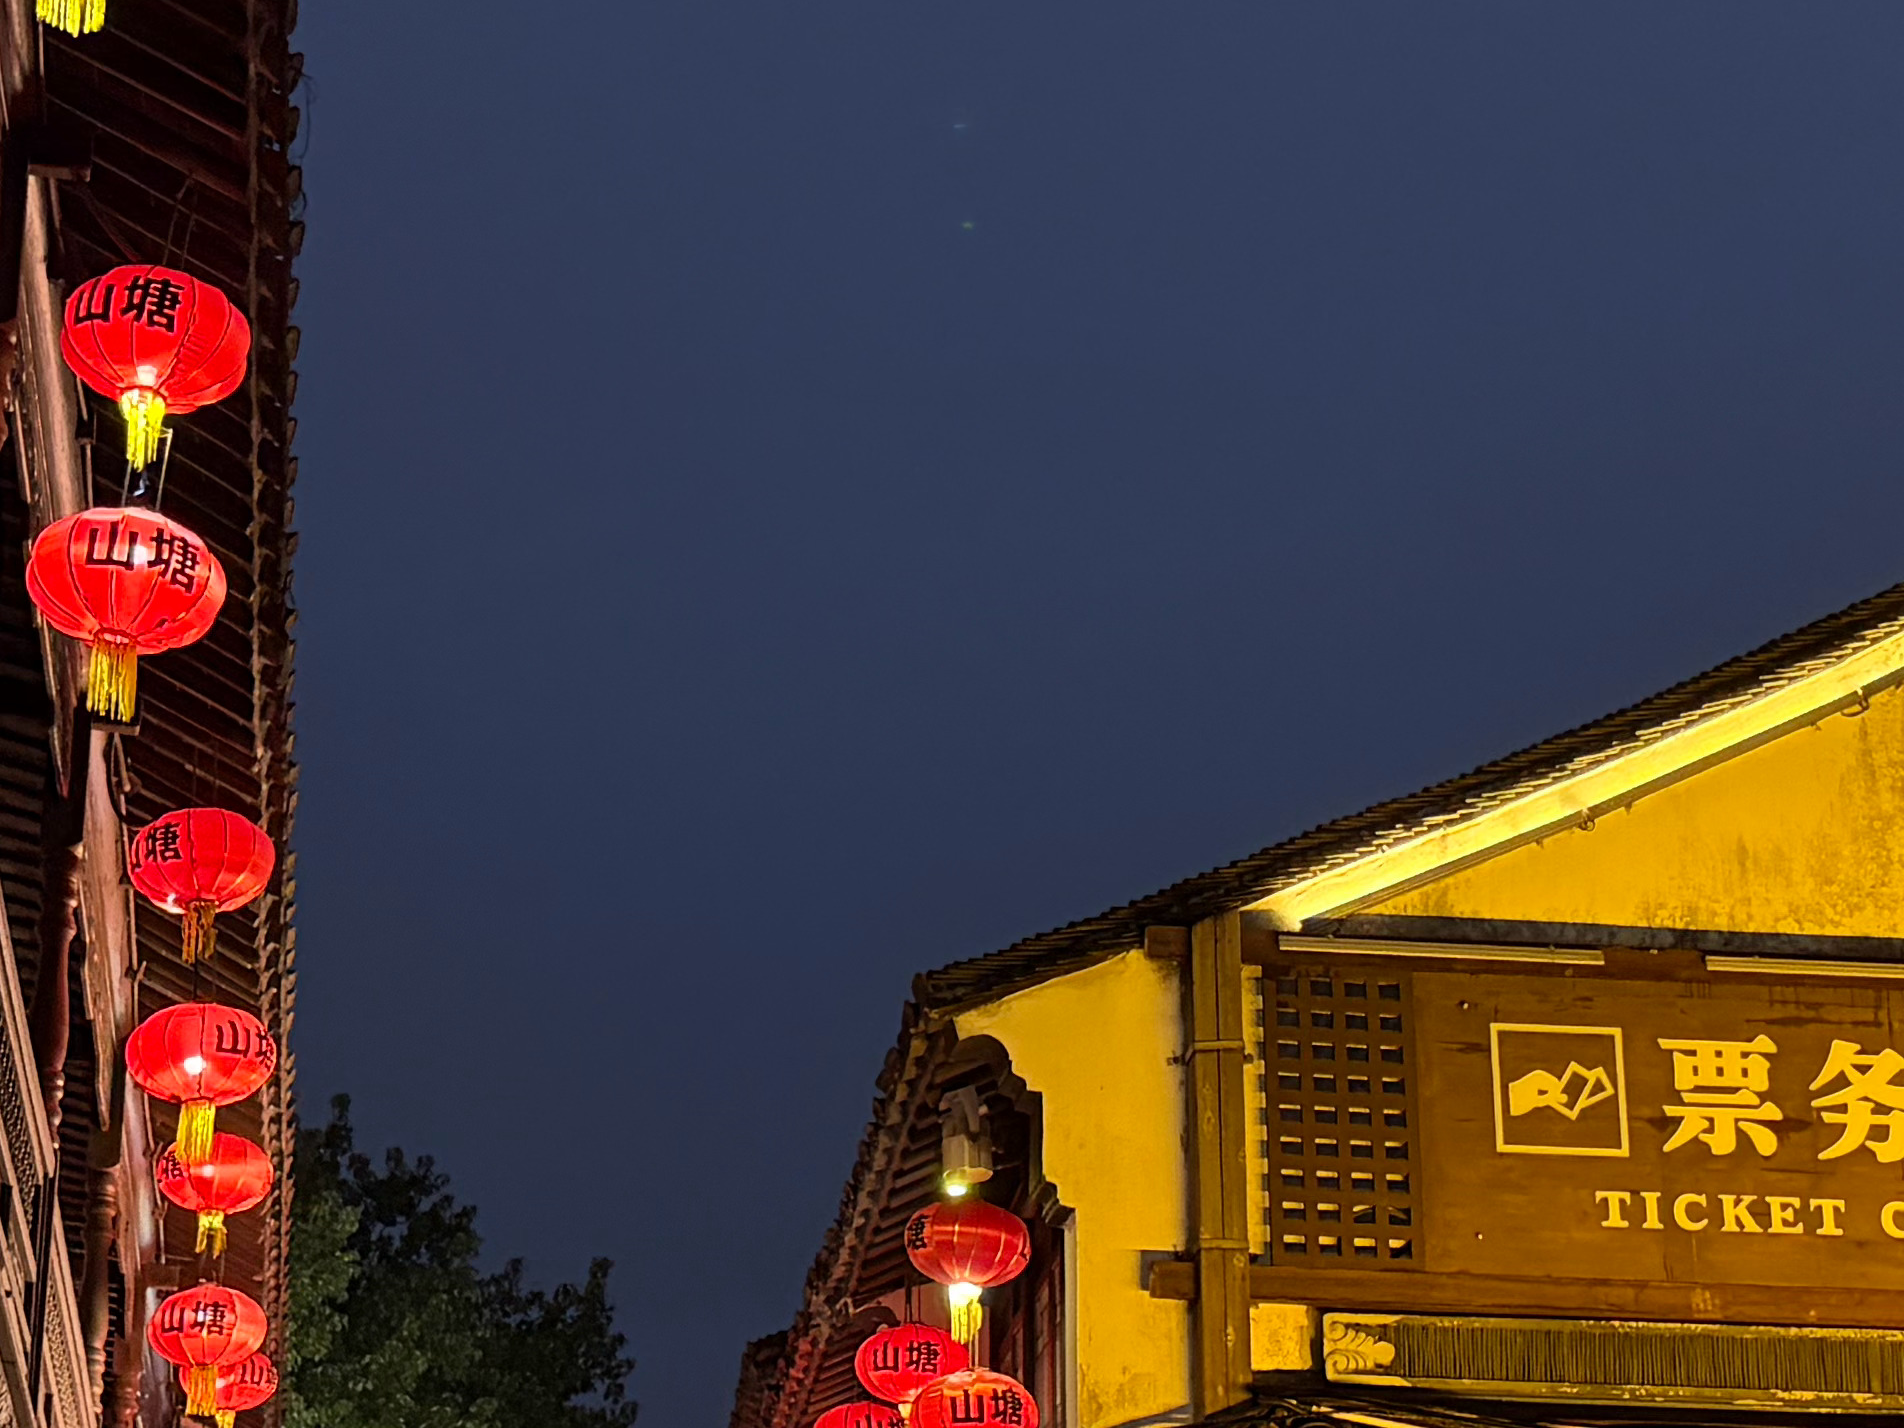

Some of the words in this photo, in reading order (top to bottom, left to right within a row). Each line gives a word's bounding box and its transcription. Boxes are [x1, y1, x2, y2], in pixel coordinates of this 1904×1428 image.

[73, 274, 183, 334] 山塘
[85, 520, 201, 594] 山塘
[1595, 1189, 1848, 1238] TICKET
[161, 1301, 228, 1336] 山塘
[873, 1339, 941, 1374] 山塘
[950, 1386, 1024, 1426] 山塘
